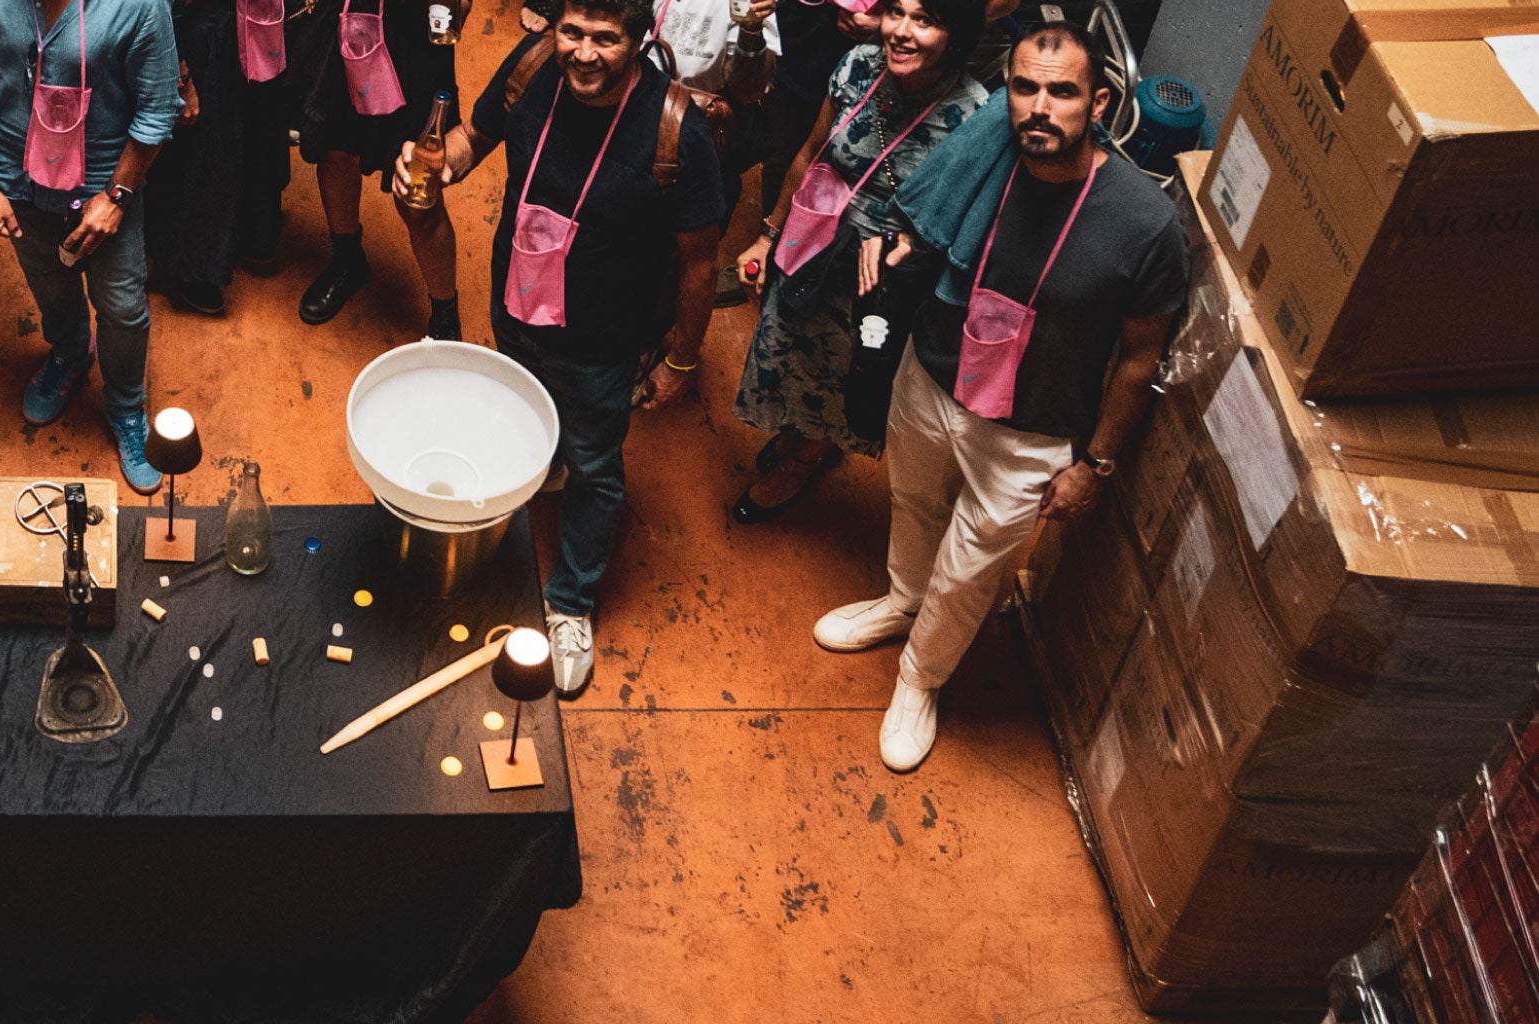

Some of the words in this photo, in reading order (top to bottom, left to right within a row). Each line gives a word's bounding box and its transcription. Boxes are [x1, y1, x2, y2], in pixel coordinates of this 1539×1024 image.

[1243, 72, 1302, 185] Sustainable
[1298, 175, 1317, 210] by
[1313, 207, 1354, 277] nature
[1260, 26, 1337, 156] AMORIM
